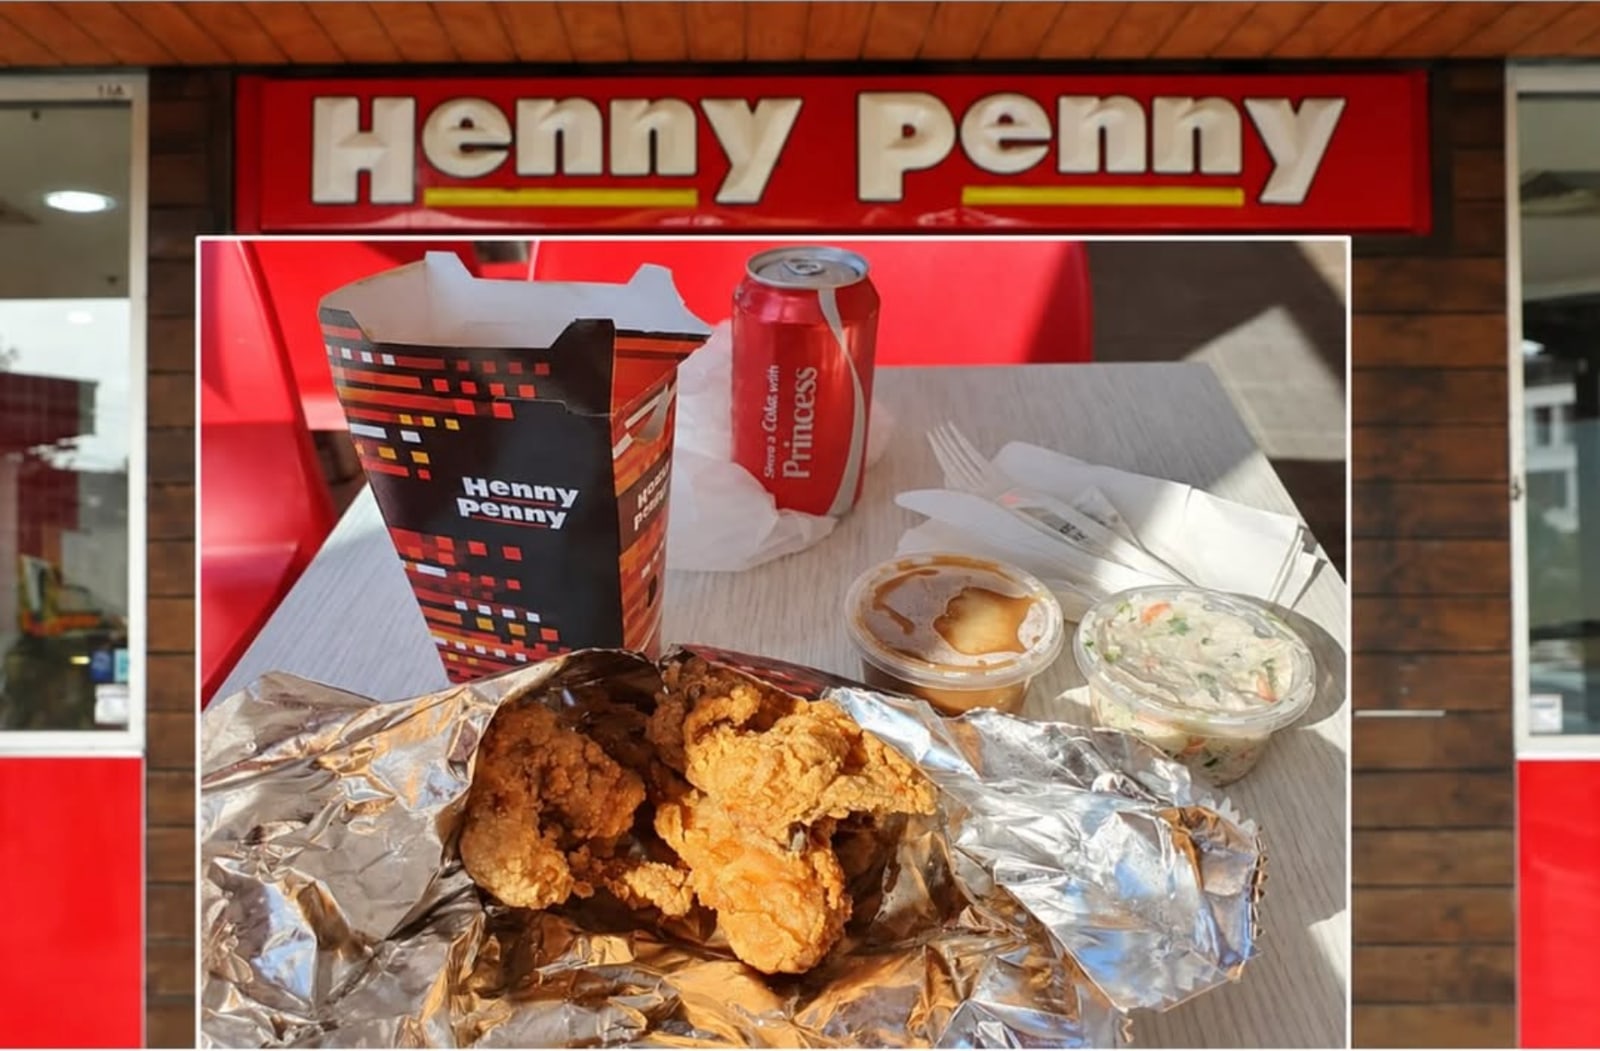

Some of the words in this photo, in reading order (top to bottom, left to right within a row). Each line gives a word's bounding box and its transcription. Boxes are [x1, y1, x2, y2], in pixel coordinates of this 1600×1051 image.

[312, 96, 803, 203] Henny
[858, 92, 1346, 204] Penny
[783, 367, 817, 478] Princess
[456, 497, 567, 529] Penny
[461, 476, 579, 508] Henny
